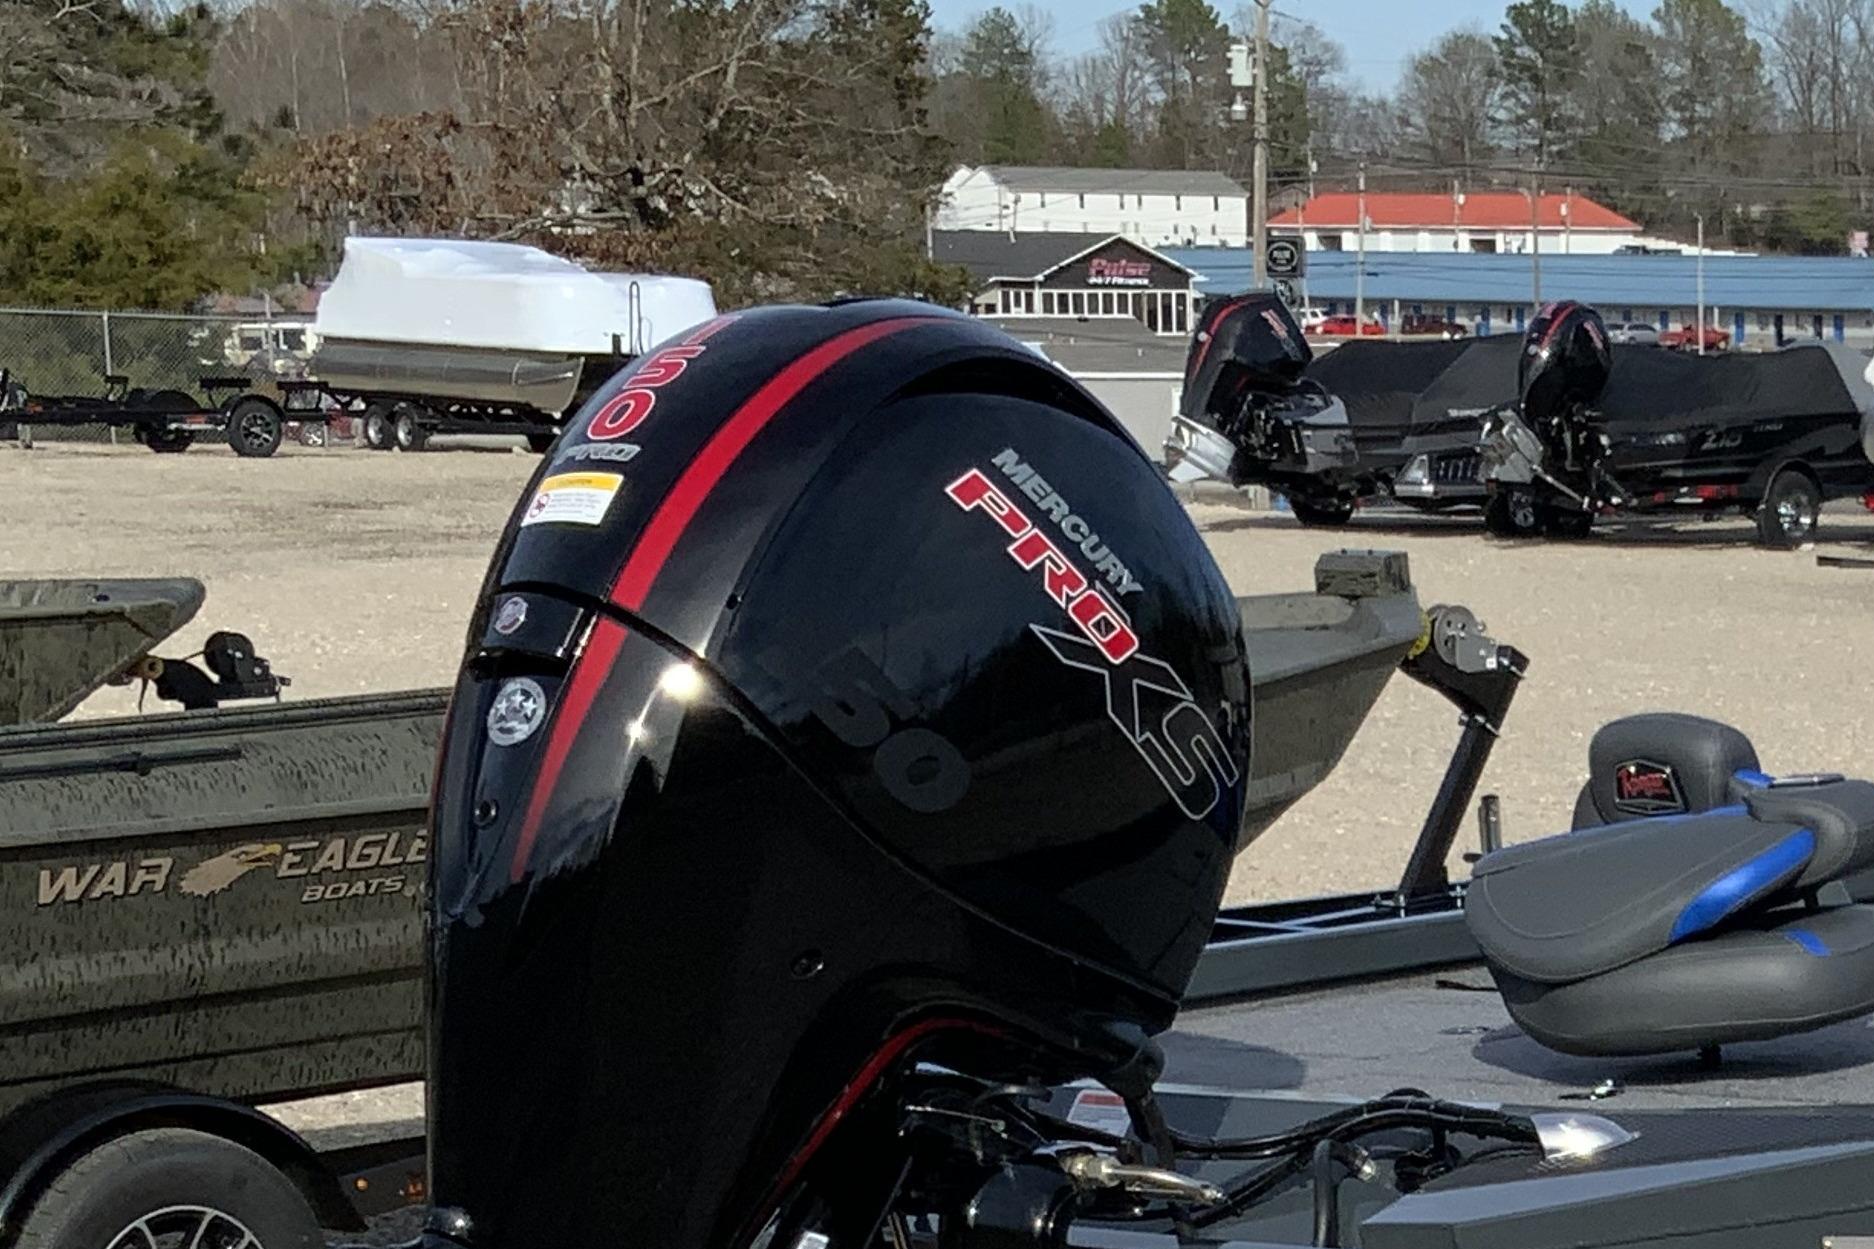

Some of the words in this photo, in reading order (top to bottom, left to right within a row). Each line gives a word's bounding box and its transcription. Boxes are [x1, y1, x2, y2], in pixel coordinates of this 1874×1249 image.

[944, 467, 1140, 665] PRO
[991, 446, 1144, 599] MERCURY
[1028, 579, 1241, 820] XS
[35, 856, 174, 909] WAR
[275, 828, 428, 879] EAGLE
